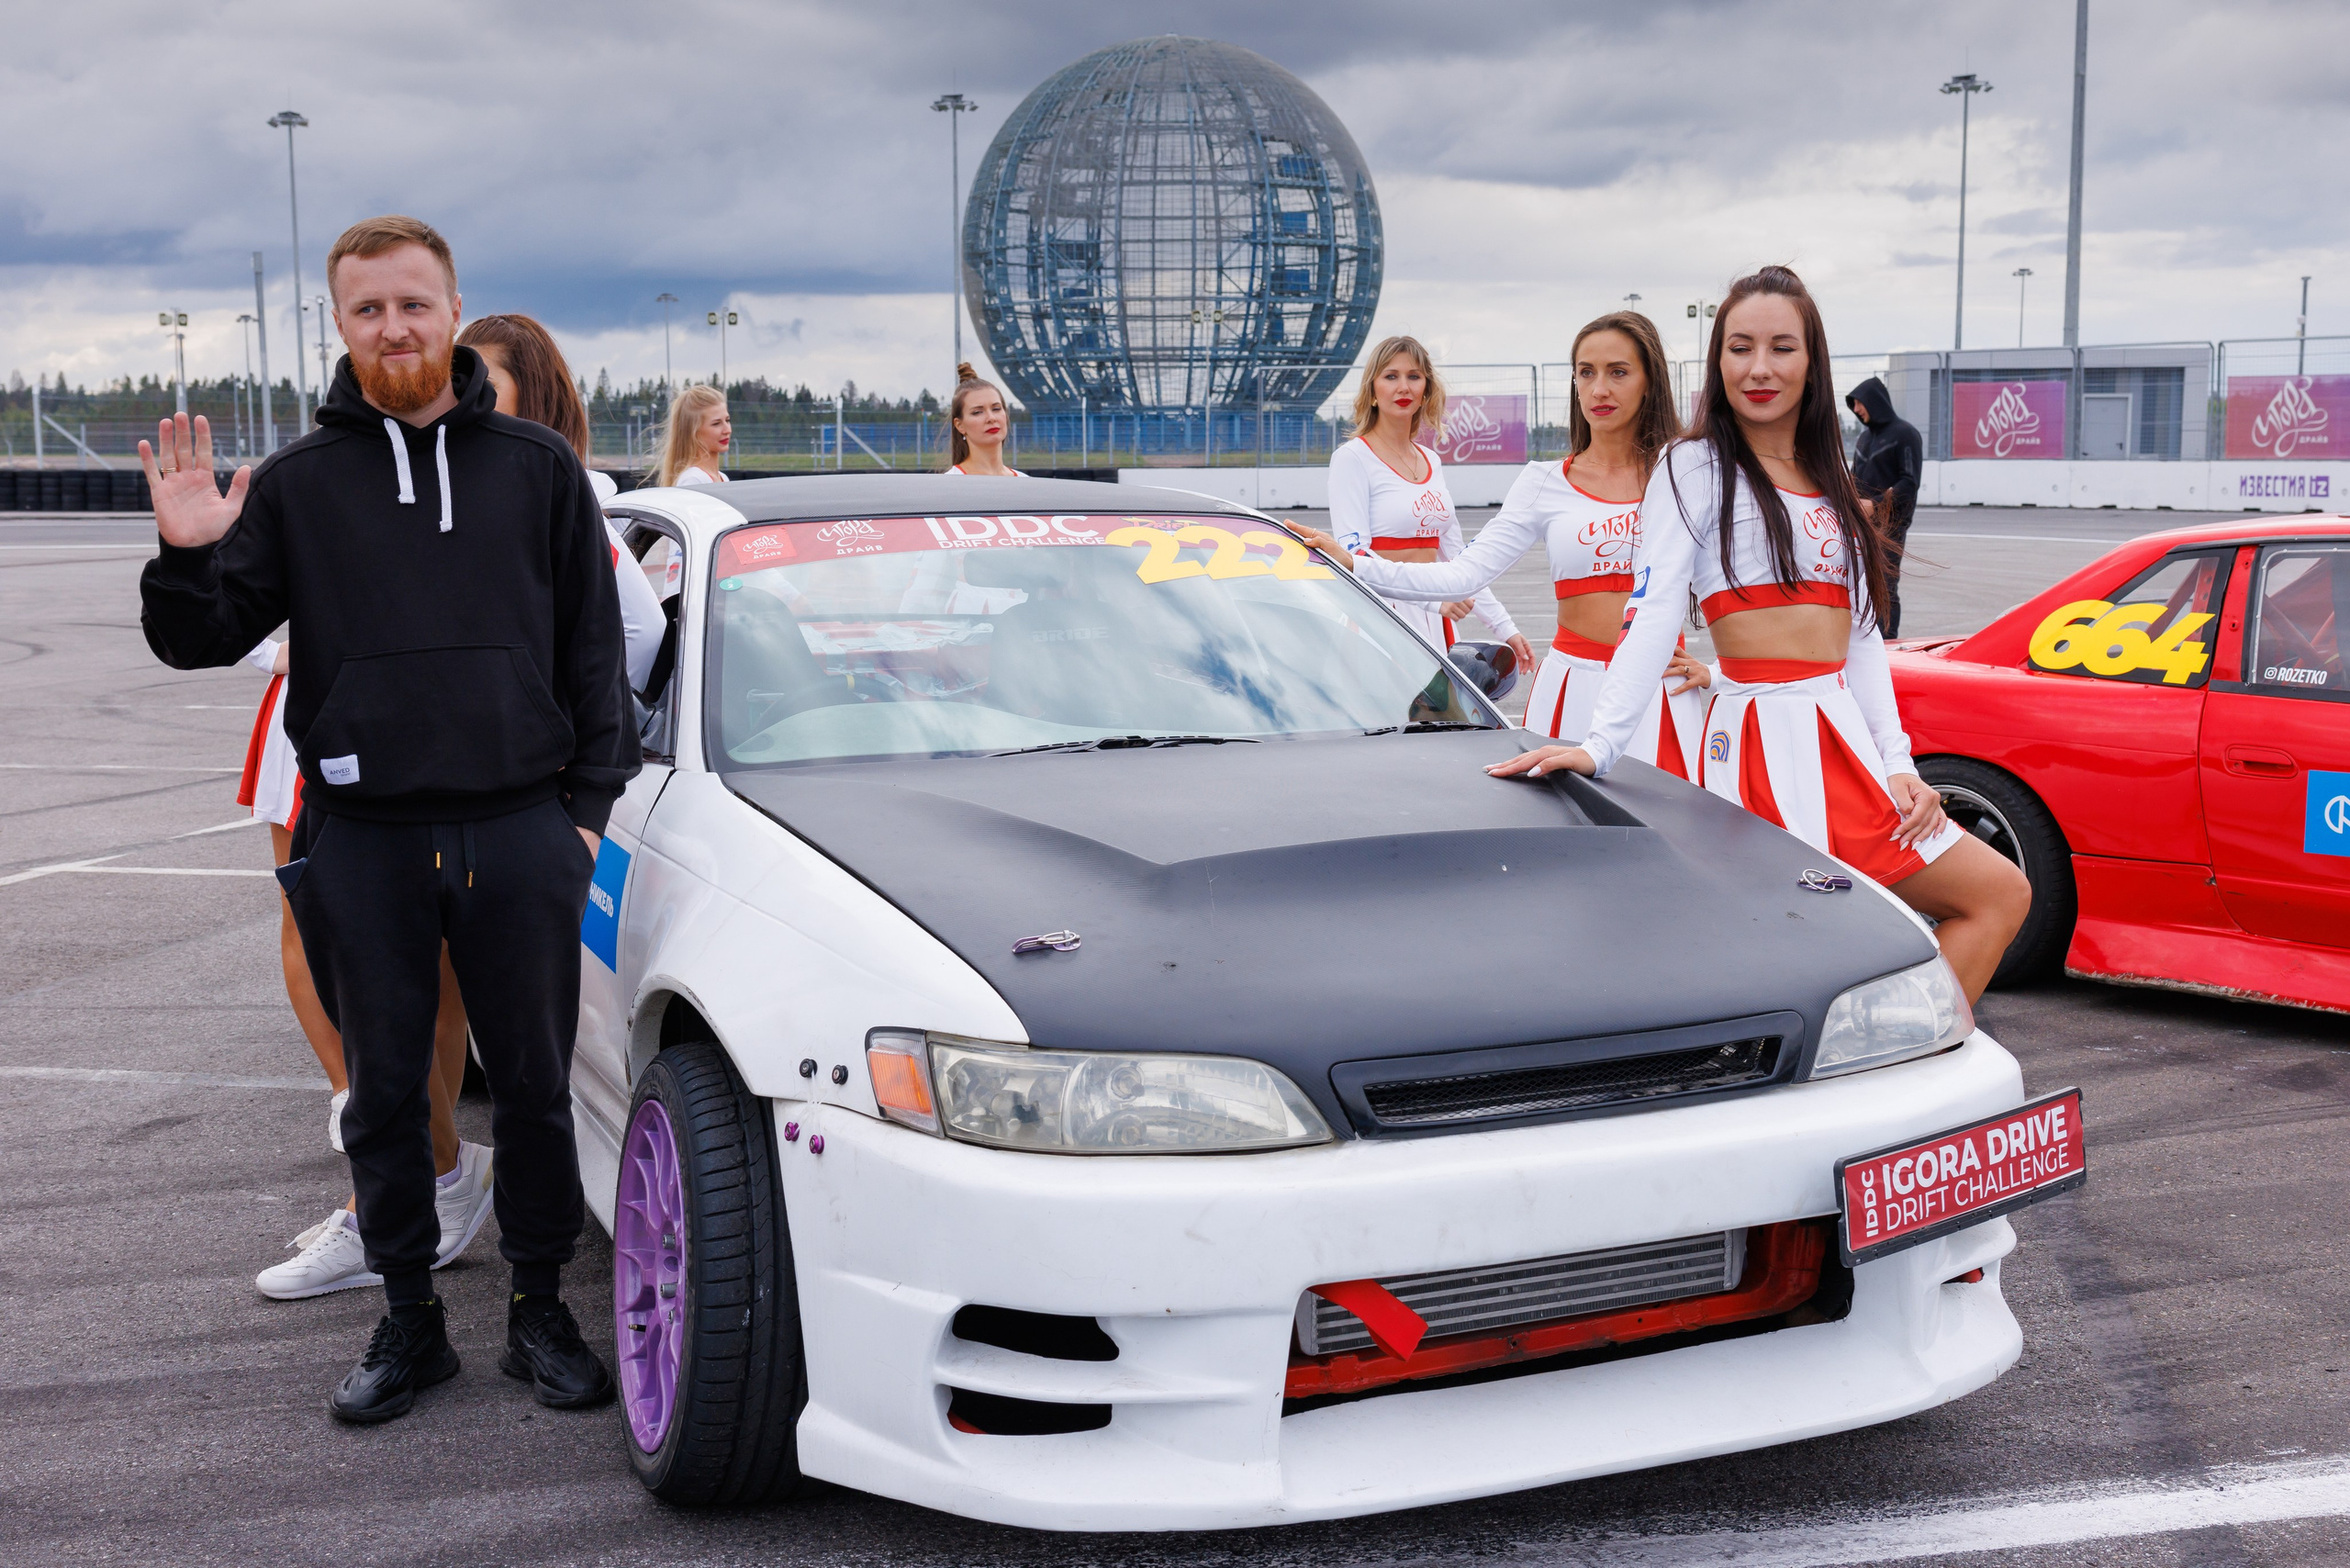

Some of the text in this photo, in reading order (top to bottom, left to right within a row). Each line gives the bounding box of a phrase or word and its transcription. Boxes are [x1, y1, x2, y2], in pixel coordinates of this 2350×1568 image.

[2299, 435, 2328, 443] ДРАЙВ
[2240, 476, 2305, 497] ИЗВЕСТИЯ
[923, 515, 1100, 541] IDDC
[1416, 528, 1439, 537] ДРАЙВ
[836, 544, 883, 555] ДРАЙВ
[938, 537, 1106, 549] DRIFT CHALLENGE
[753, 552, 782, 560] ДРАЙВ
[1105, 526, 1337, 585] 222
[1593, 558, 1633, 572] ДРАЙ
[2029, 599, 2215, 684] 664
[2277, 666, 2328, 685] ROZETKO
[1882, 1104, 2067, 1200] IGORA DRIVE
[1886, 1143, 2069, 1231] DRIFT CHALLENGE
[1862, 1169, 1879, 1238] IDDC
